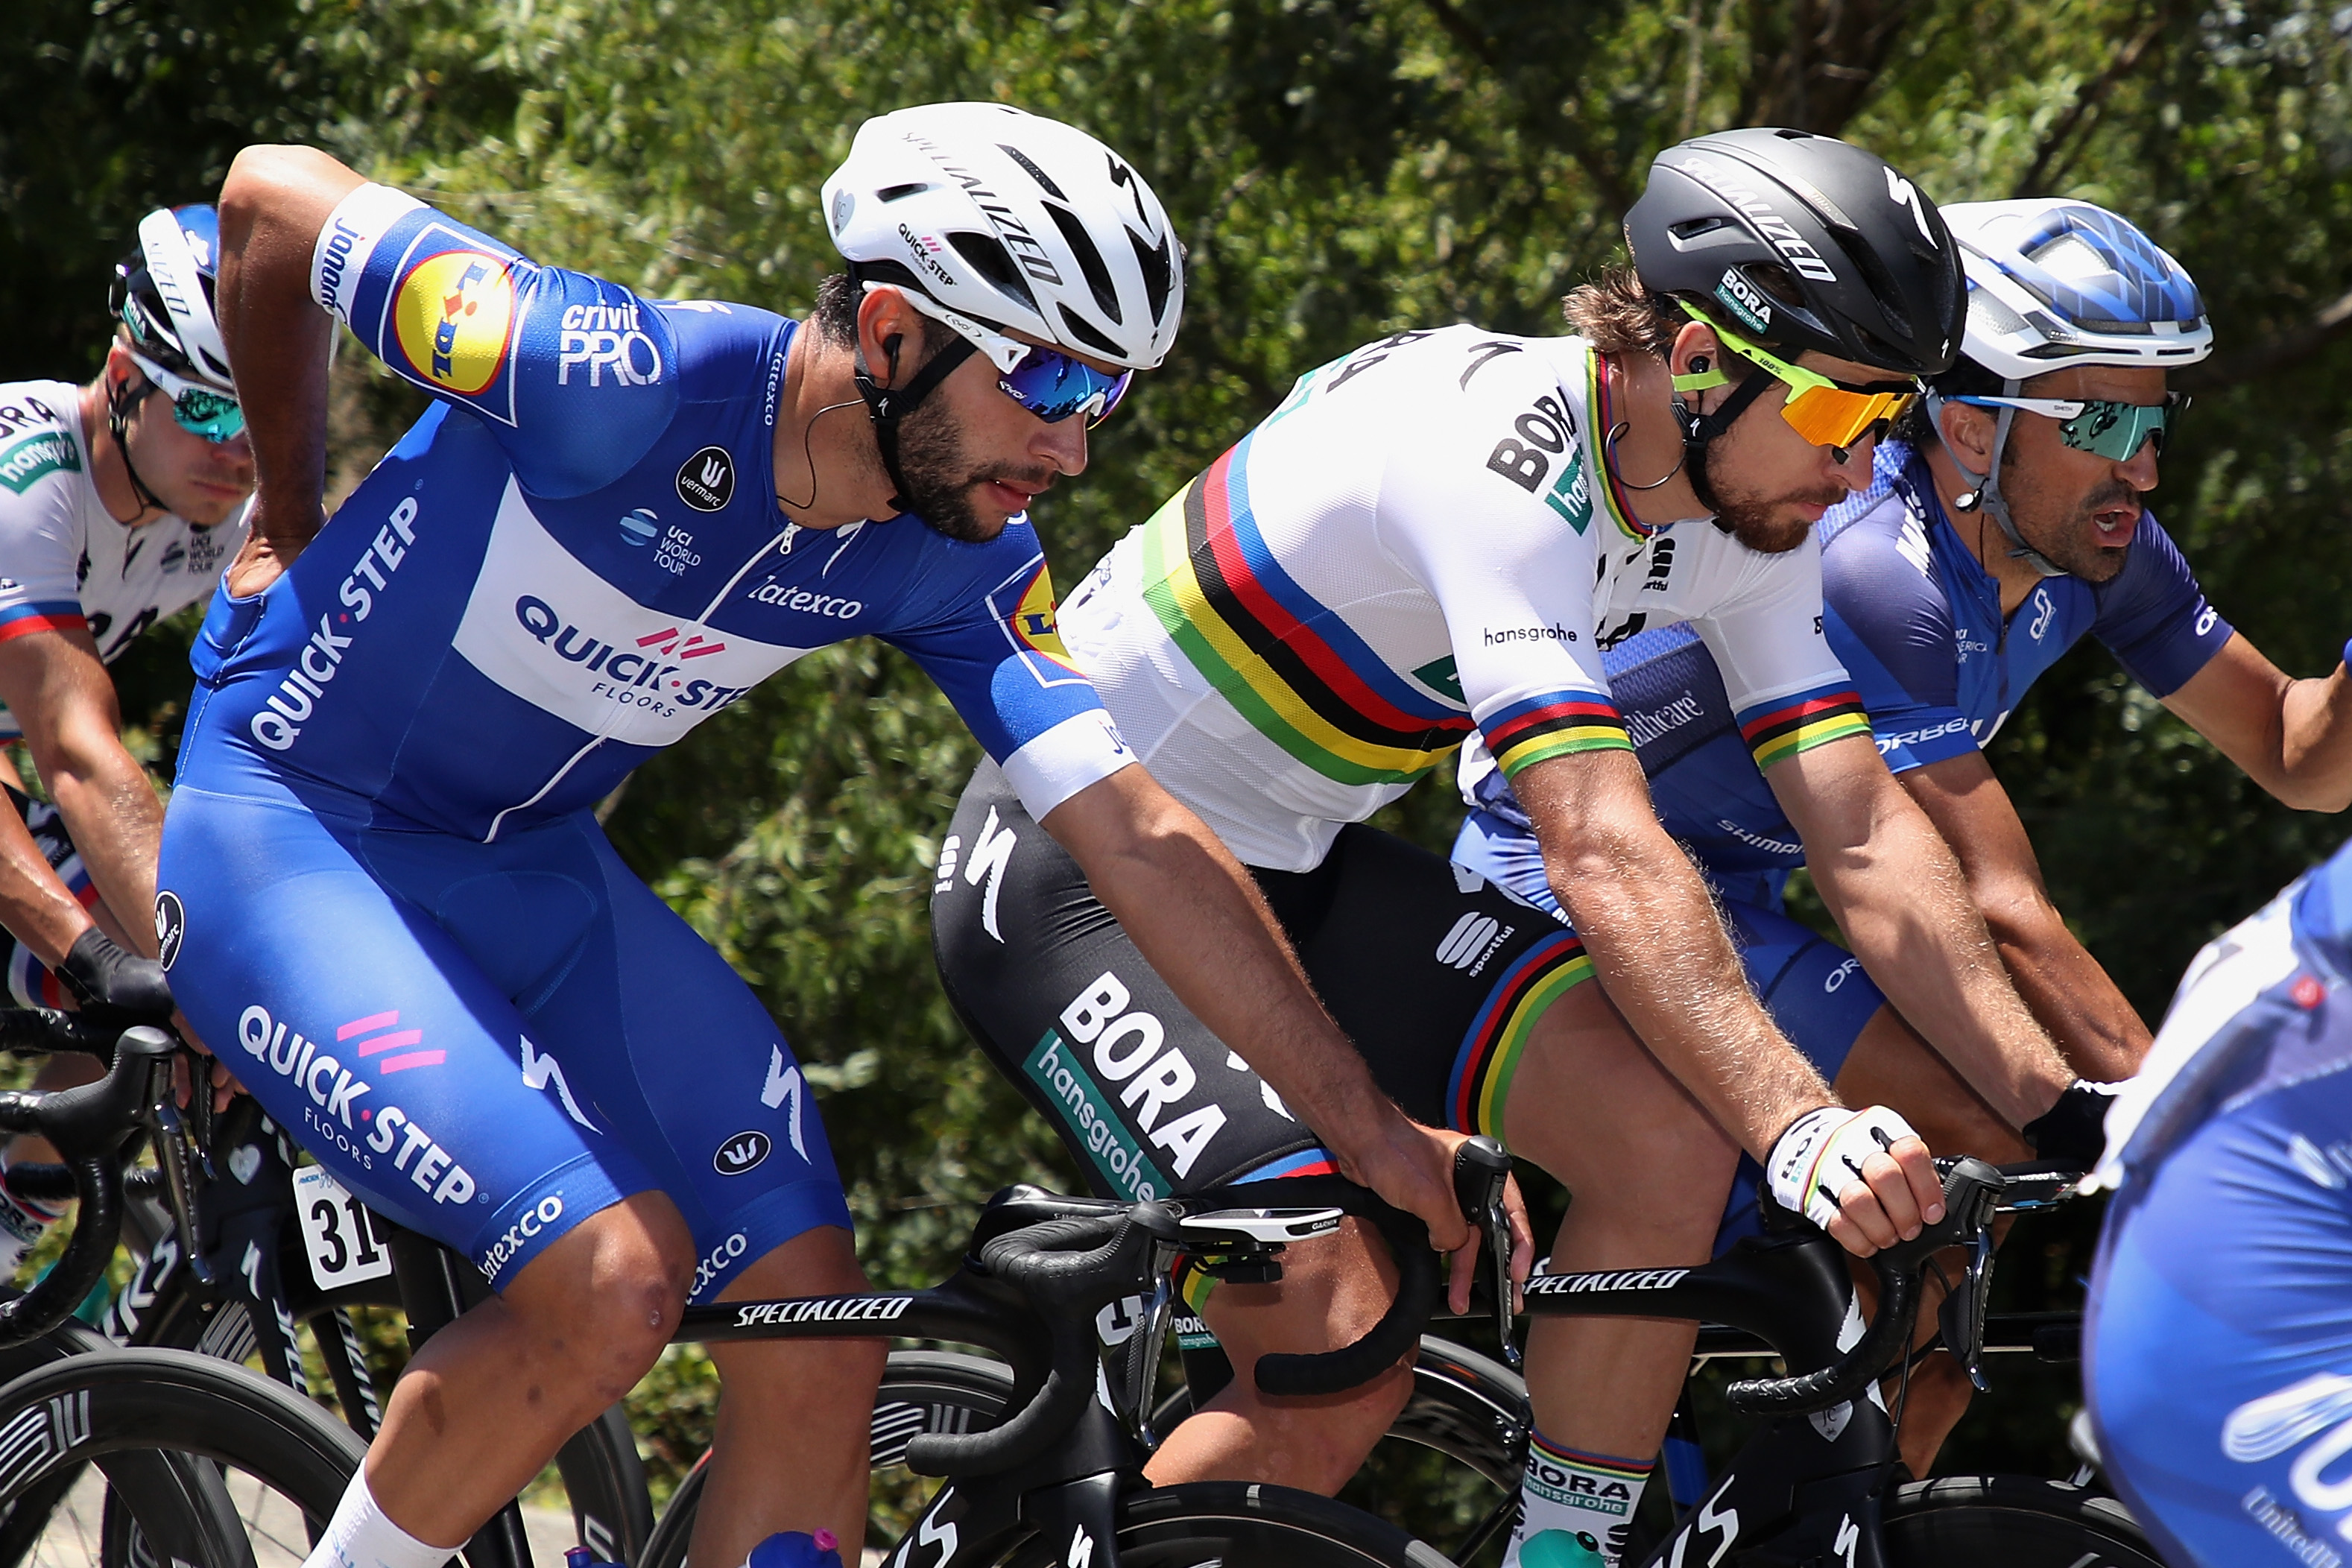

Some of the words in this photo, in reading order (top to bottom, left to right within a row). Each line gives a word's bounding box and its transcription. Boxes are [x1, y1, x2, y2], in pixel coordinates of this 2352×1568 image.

[902, 132, 1063, 285] SPECIALIZED
[1674, 157, 1837, 282] SPECIALIZED
[560, 300, 639, 331] crivit
[1719, 285, 1763, 330] hansgrohe
[1722, 269, 1771, 324] BORA
[557, 329, 663, 387] PRO
[1758, 358, 1784, 375] 100%
[763, 352, 785, 426] latexco
[681, 475, 721, 507] vermarc
[660, 537, 701, 567] WORLD
[667, 525, 693, 546] UCI
[653, 549, 686, 577] TOUR
[747, 575, 862, 619] latexco
[1484, 622, 1578, 647] hansgrohe
[592, 682, 676, 718] FLOORS
[1468, 925, 1515, 979] sportful
[1059, 970, 1227, 1180] BORA
[304, 1107, 373, 1171] FLOORS
[1037, 1036, 1157, 1204] hansgrohe
[311, 1197, 379, 1273] 31
[733, 1296, 914, 1327] SPECIALIZED
[1525, 1478, 1623, 1513] hansgrohe
[1526, 1455, 1631, 1501] BORA
